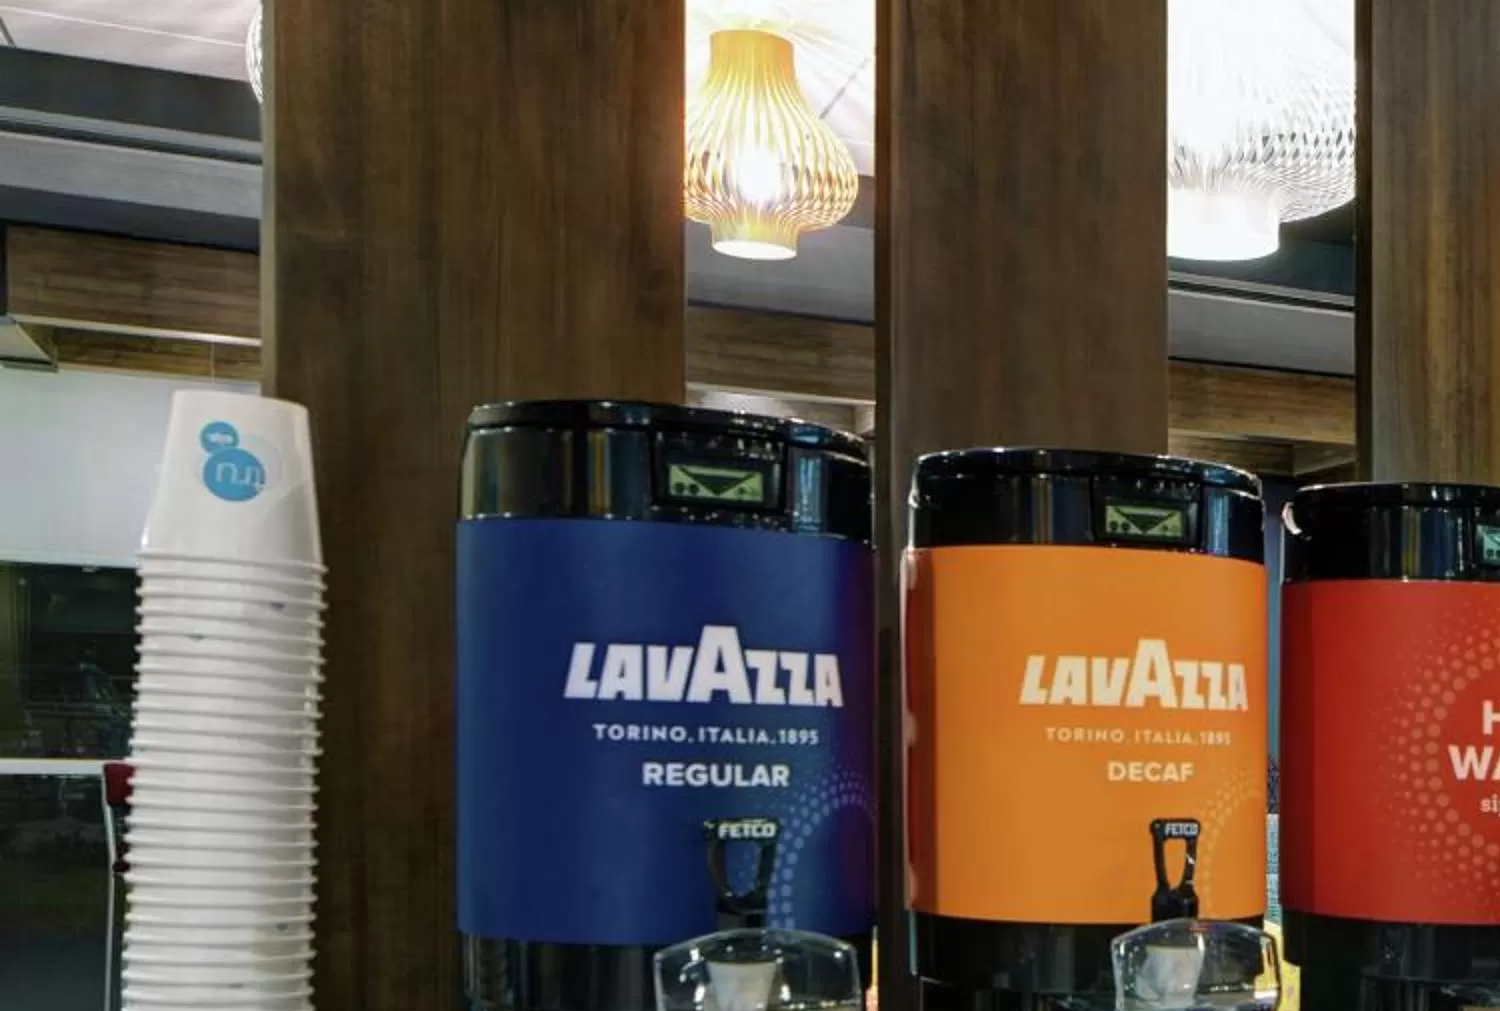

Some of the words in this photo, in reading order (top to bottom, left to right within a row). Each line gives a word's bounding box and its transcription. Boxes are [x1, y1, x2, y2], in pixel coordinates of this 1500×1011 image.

[563, 624, 844, 708] LAVAZZA
[1018, 637, 1249, 711] LAVAZZA
[779, 728, 819, 745] 1895
[642, 762, 790, 788] REGULAR
[1107, 760, 1195, 783] DECAF
